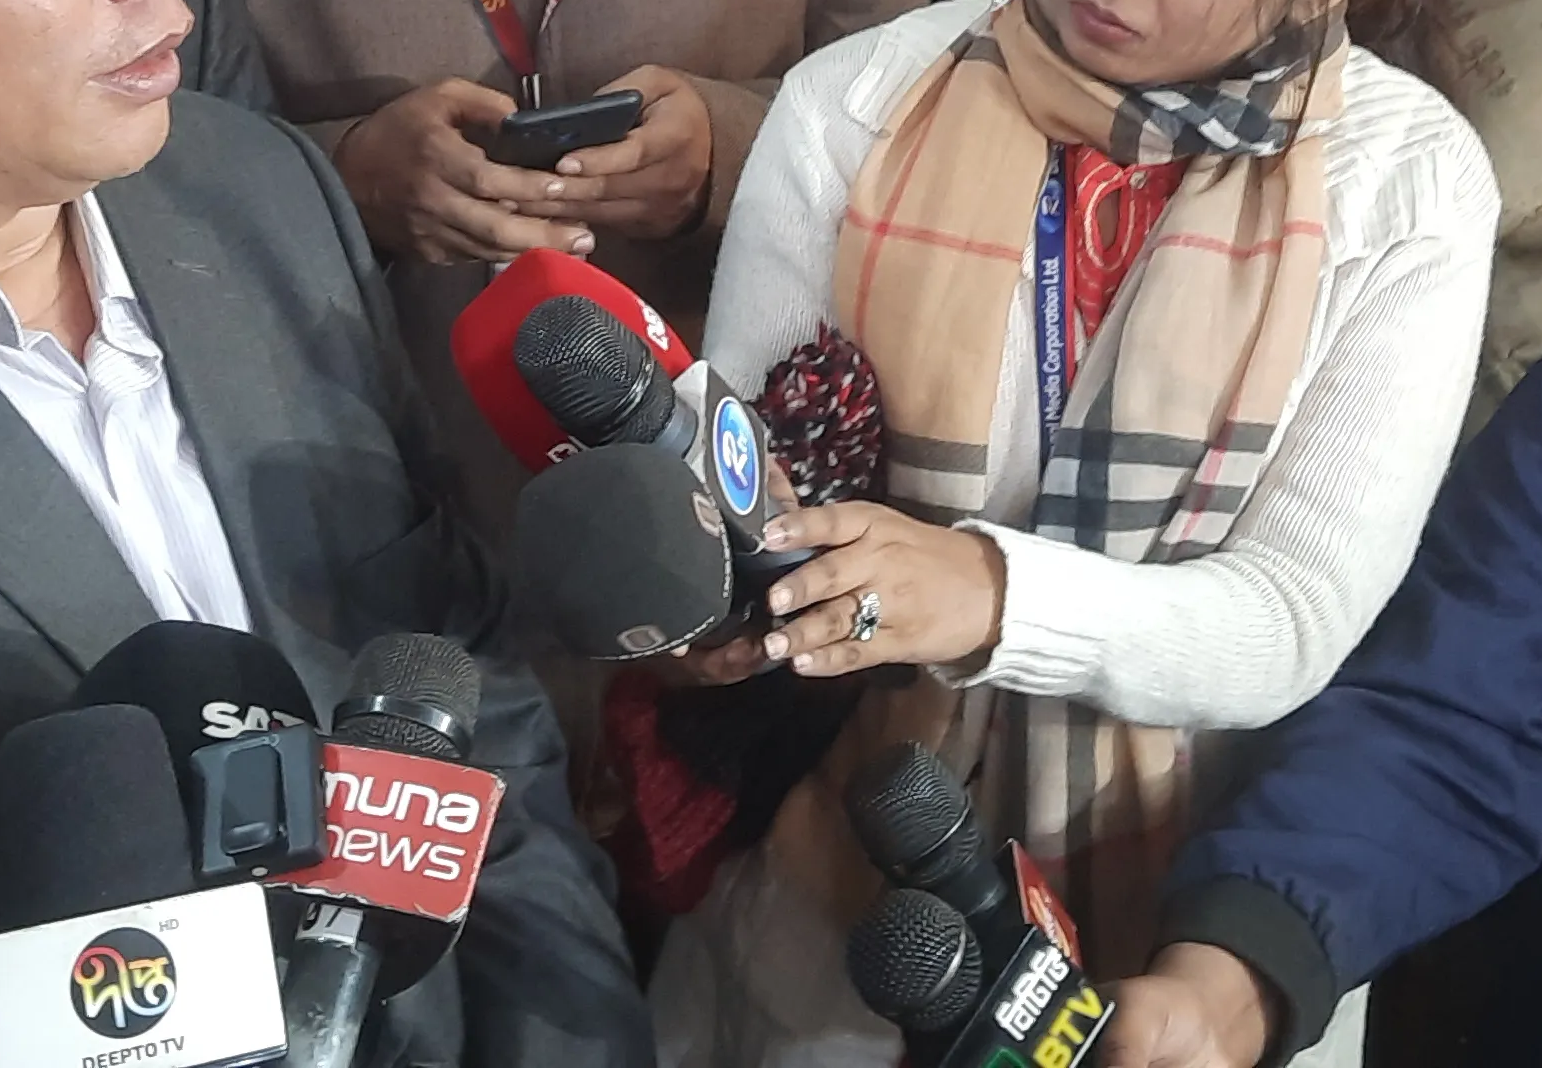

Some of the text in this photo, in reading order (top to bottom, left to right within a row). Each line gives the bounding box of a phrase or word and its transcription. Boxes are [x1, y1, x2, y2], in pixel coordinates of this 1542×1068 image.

[1040, 286, 1065, 373] Corporation
[158, 918, 180, 932] HD
[73, 945, 176, 1029] দীপ্ত
[994, 945, 1070, 1042] বিটিভি
[1032, 986, 1105, 1068] BTV
[81, 1035, 185, 1068] DEEPTO TV
